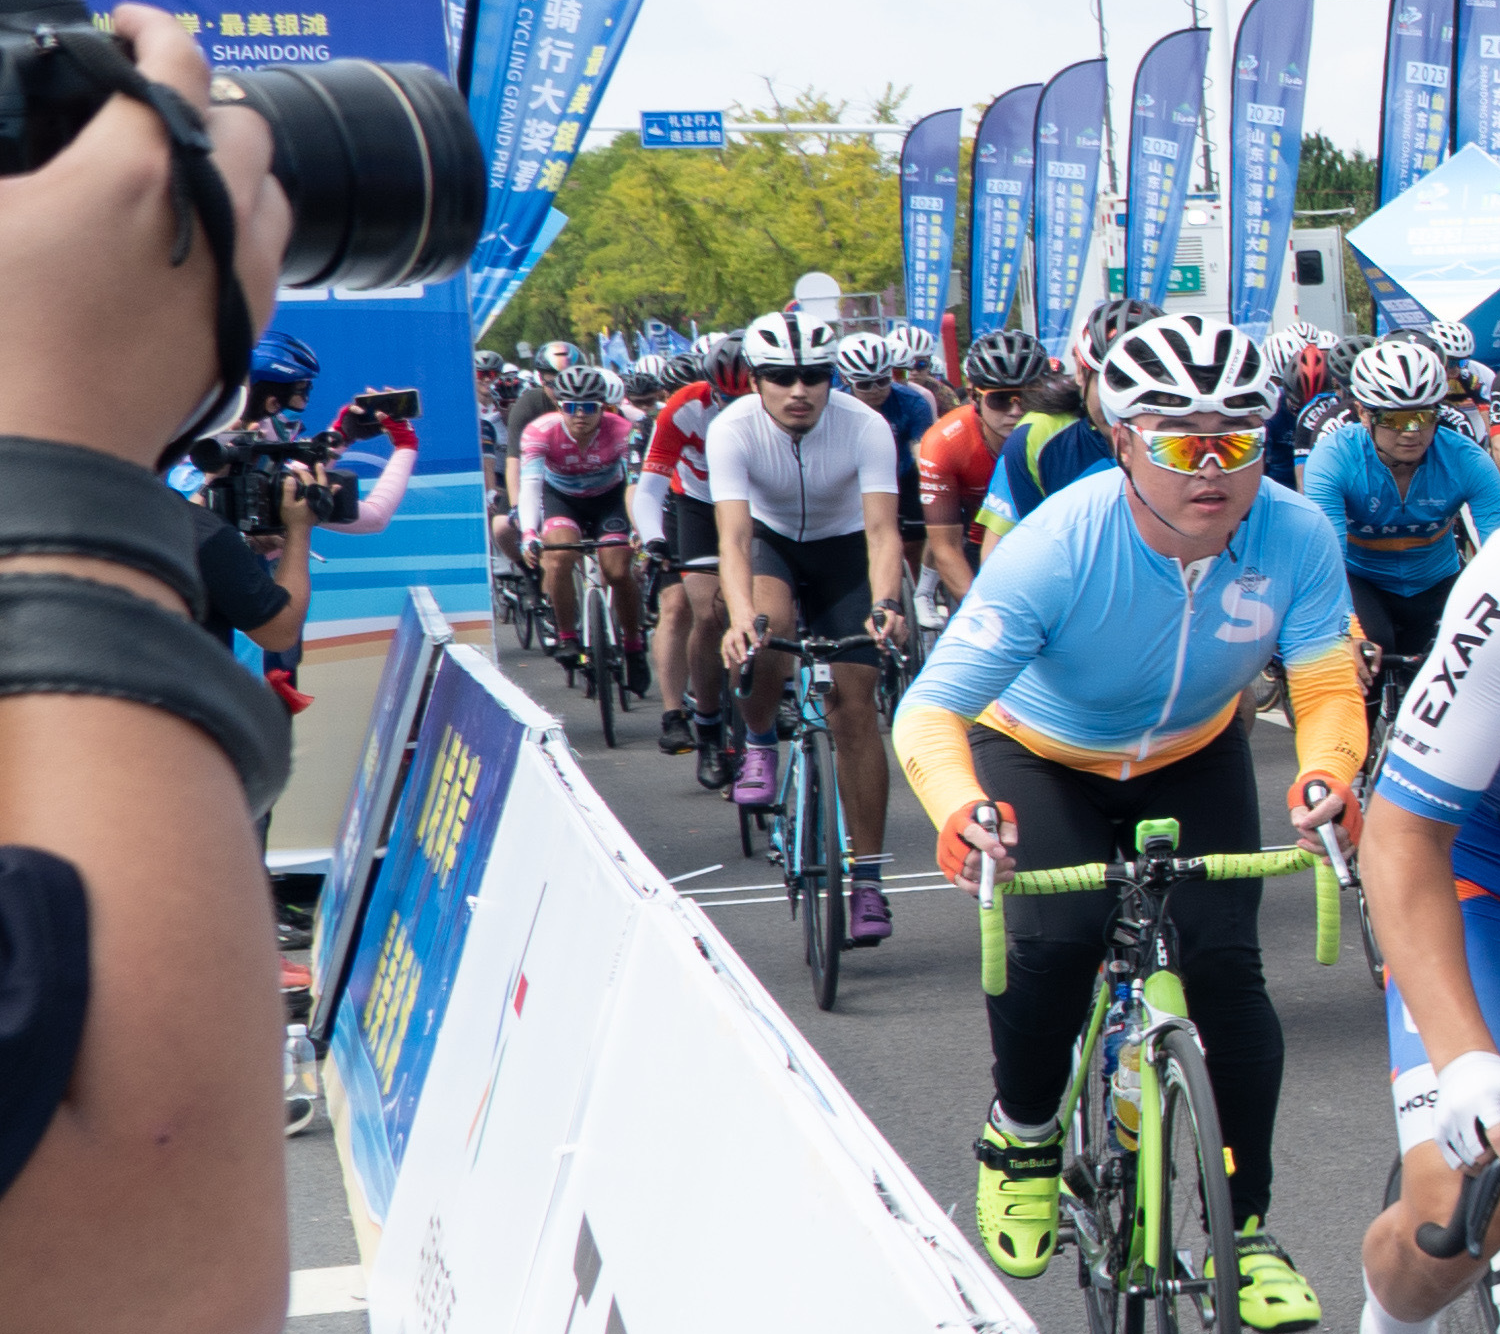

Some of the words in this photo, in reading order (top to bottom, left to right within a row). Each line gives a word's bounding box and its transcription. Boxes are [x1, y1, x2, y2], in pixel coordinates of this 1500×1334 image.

[212, 44, 331, 62] SHANDONG
[506, 3, 535, 82] CYCLING
[1409, 64, 1446, 85] 2023
[497, 85, 521, 147] GRAND
[1248, 105, 1284, 124] 2023
[1143, 138, 1177, 157] 2023
[490, 149, 508, 190] PRIX
